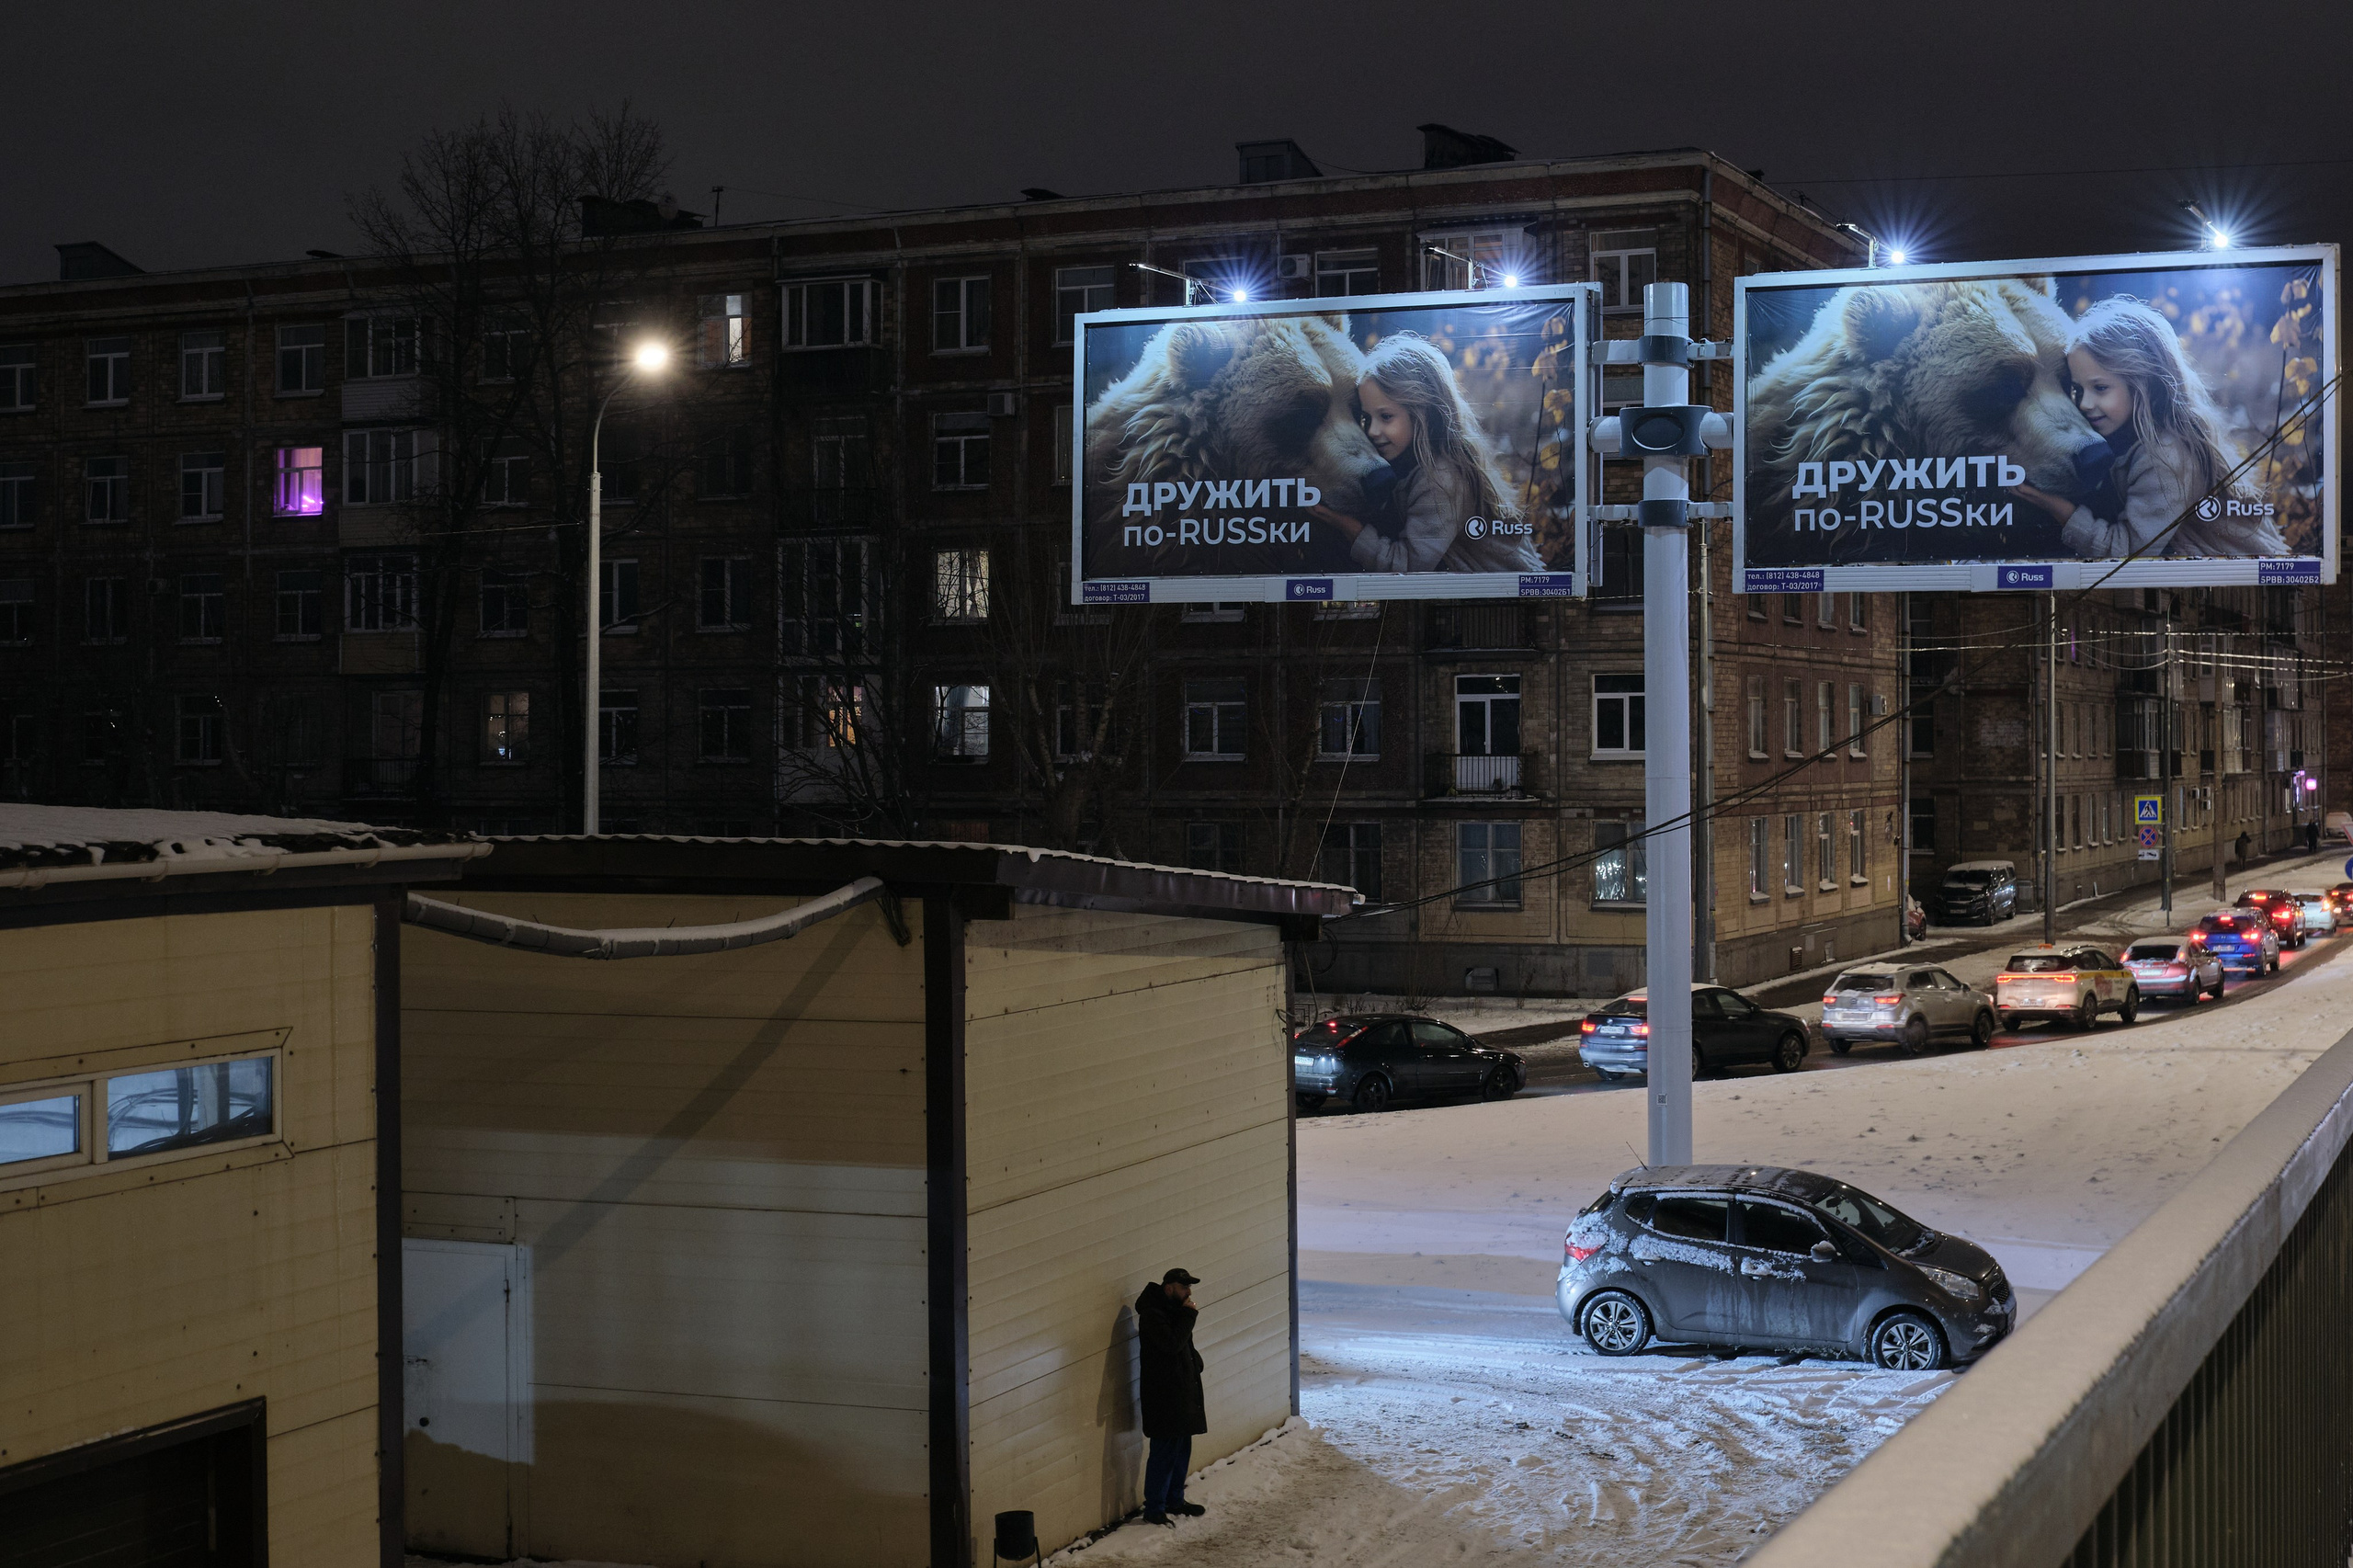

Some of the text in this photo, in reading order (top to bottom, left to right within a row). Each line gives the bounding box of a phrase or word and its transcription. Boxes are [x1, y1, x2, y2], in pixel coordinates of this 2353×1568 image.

[1792, 455, 2026, 500] ДРУЖИТЬ
[1122, 478, 1322, 517] ДРУЖИТЬ
[1794, 497, 2013, 531] по-RUSSки
[2226, 500, 2274, 517] Russ
[1124, 517, 1311, 547] по-RUSSки
[1492, 519, 1533, 536] Russ
[1766, 572, 1784, 580] (812)
[1786, 571, 1820, 579] 438-4848
[2021, 573, 2044, 582] Russ
[1306, 585, 1326, 594] Russ
